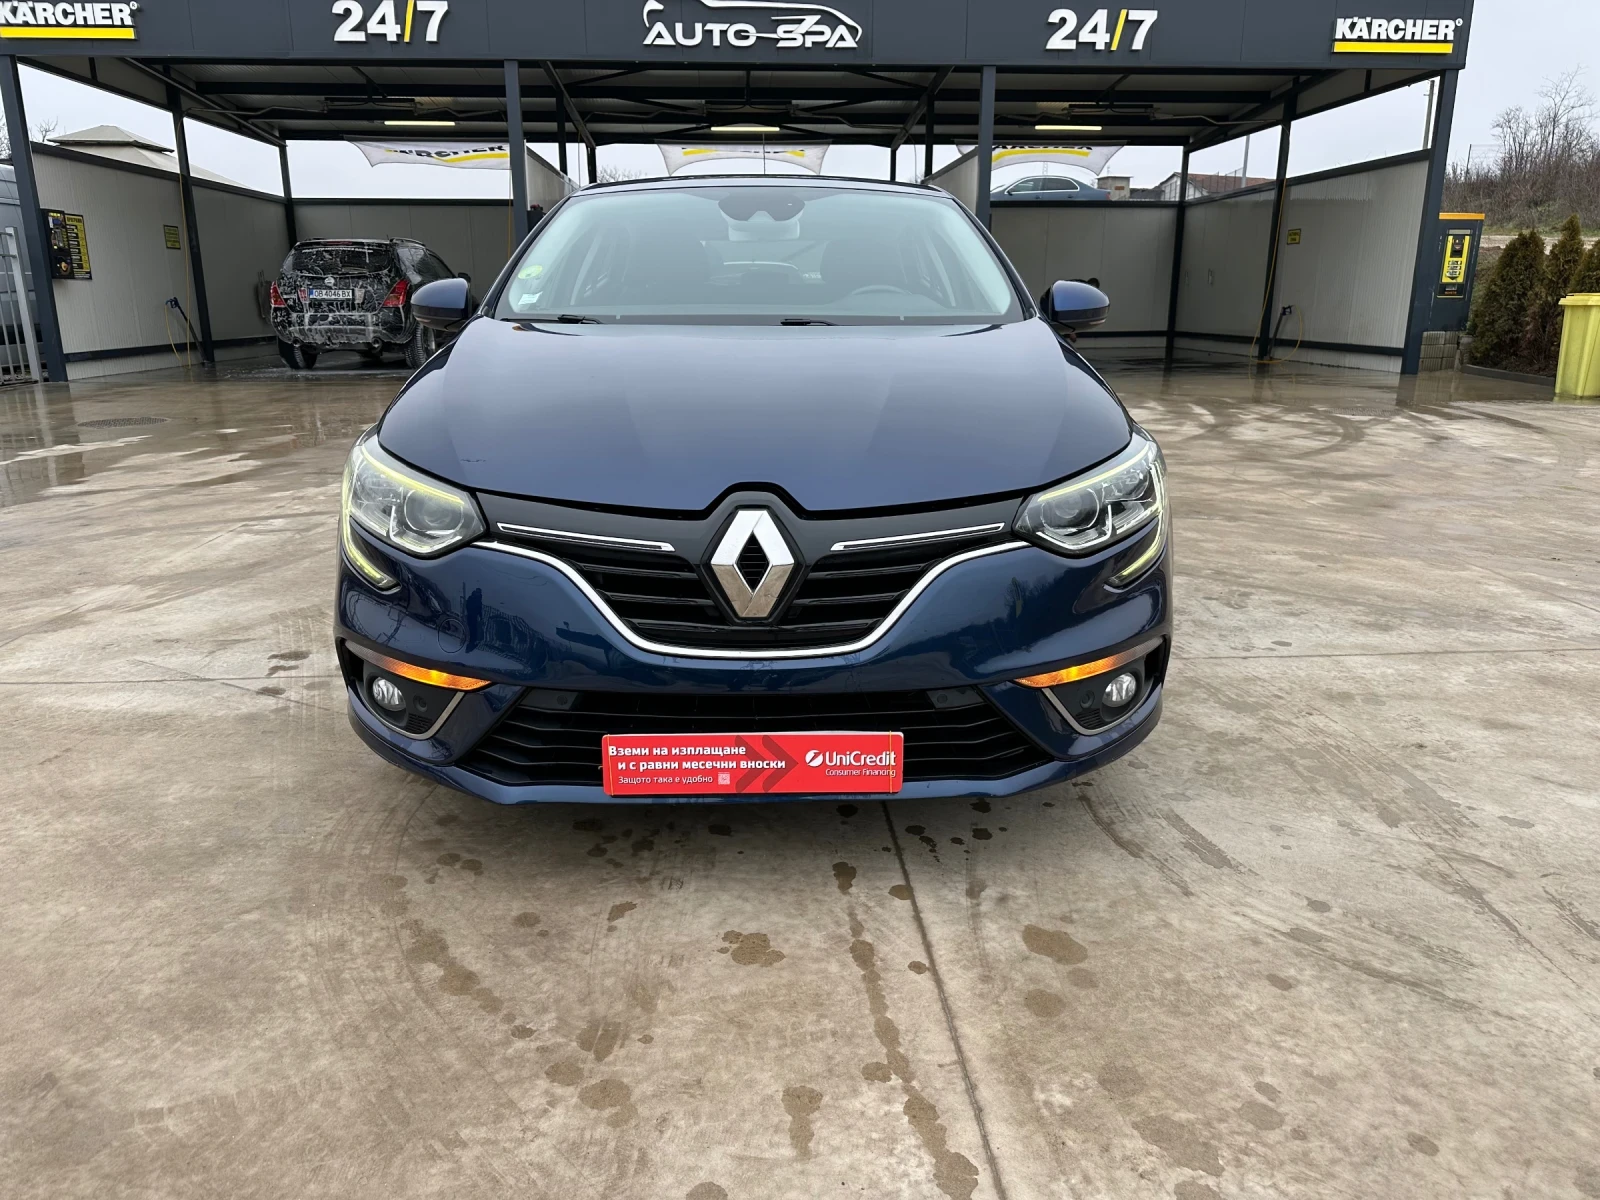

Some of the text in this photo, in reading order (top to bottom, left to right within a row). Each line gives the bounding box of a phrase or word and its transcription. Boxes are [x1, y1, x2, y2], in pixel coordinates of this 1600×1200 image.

[331, 0, 448, 42] 24/7
[642, 15, 858, 48] AUTO SPA
[1045, 8, 1158, 50] 24/7
[324, 290, 340, 298] 4046
[341, 290, 351, 298] BX
[609, 746, 746, 757] Вземи на изплащане
[825, 750, 896, 766] UniCredit
[617, 760, 786, 772] и с равни месечни вноски
[825, 768, 896, 777] Consumer Financing
[618, 776, 651, 784] Защото
[682, 775, 713, 784] удобно
